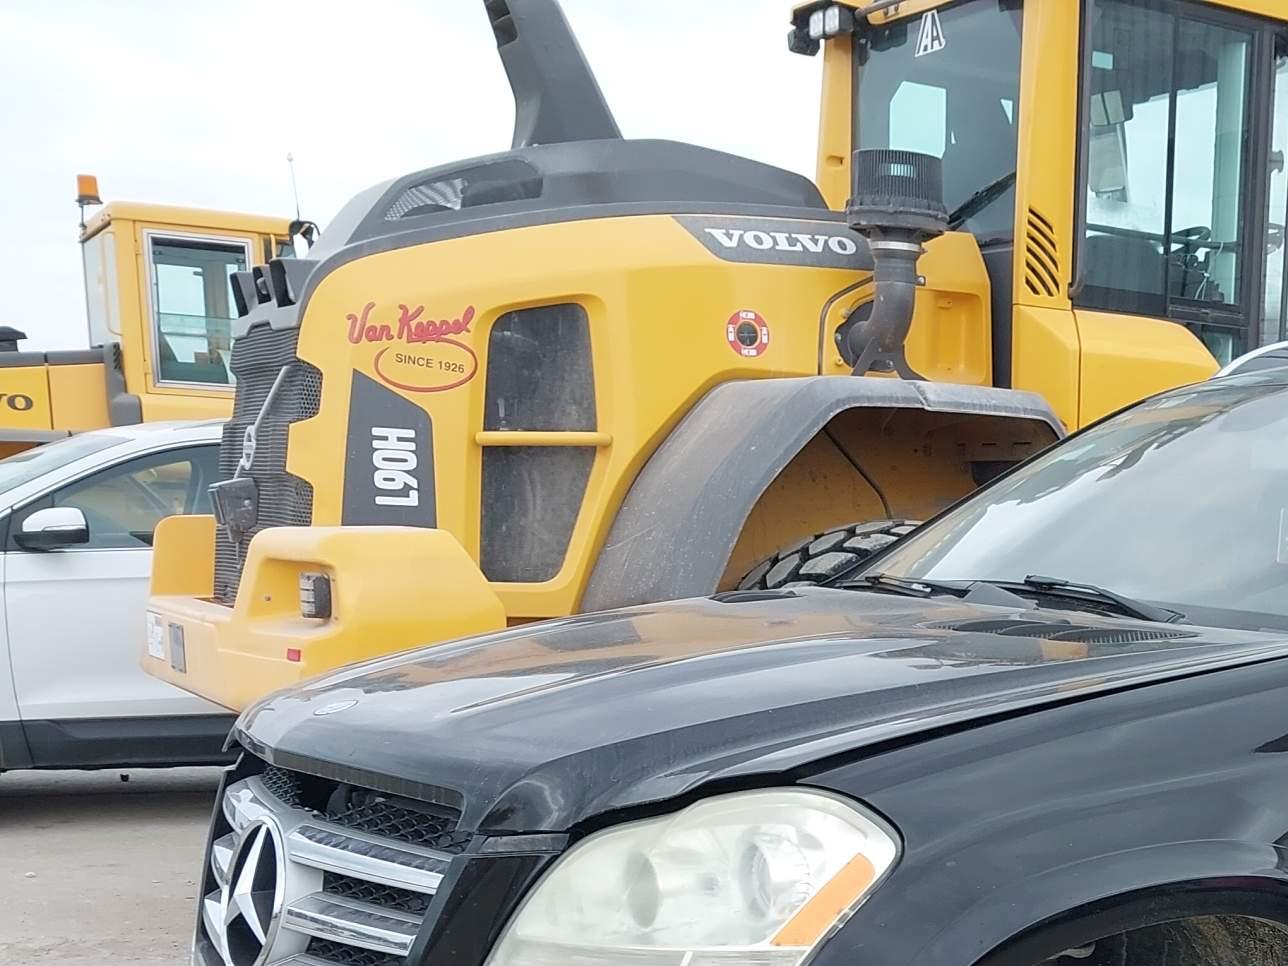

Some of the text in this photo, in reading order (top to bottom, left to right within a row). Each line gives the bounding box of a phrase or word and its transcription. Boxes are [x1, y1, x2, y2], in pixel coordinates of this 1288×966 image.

[704, 228, 857, 255] VOLVO
[346, 303, 475, 344] Van Keppel
[395, 353, 465, 374] SINCE 1926
[371, 427, 418, 506] L90H
